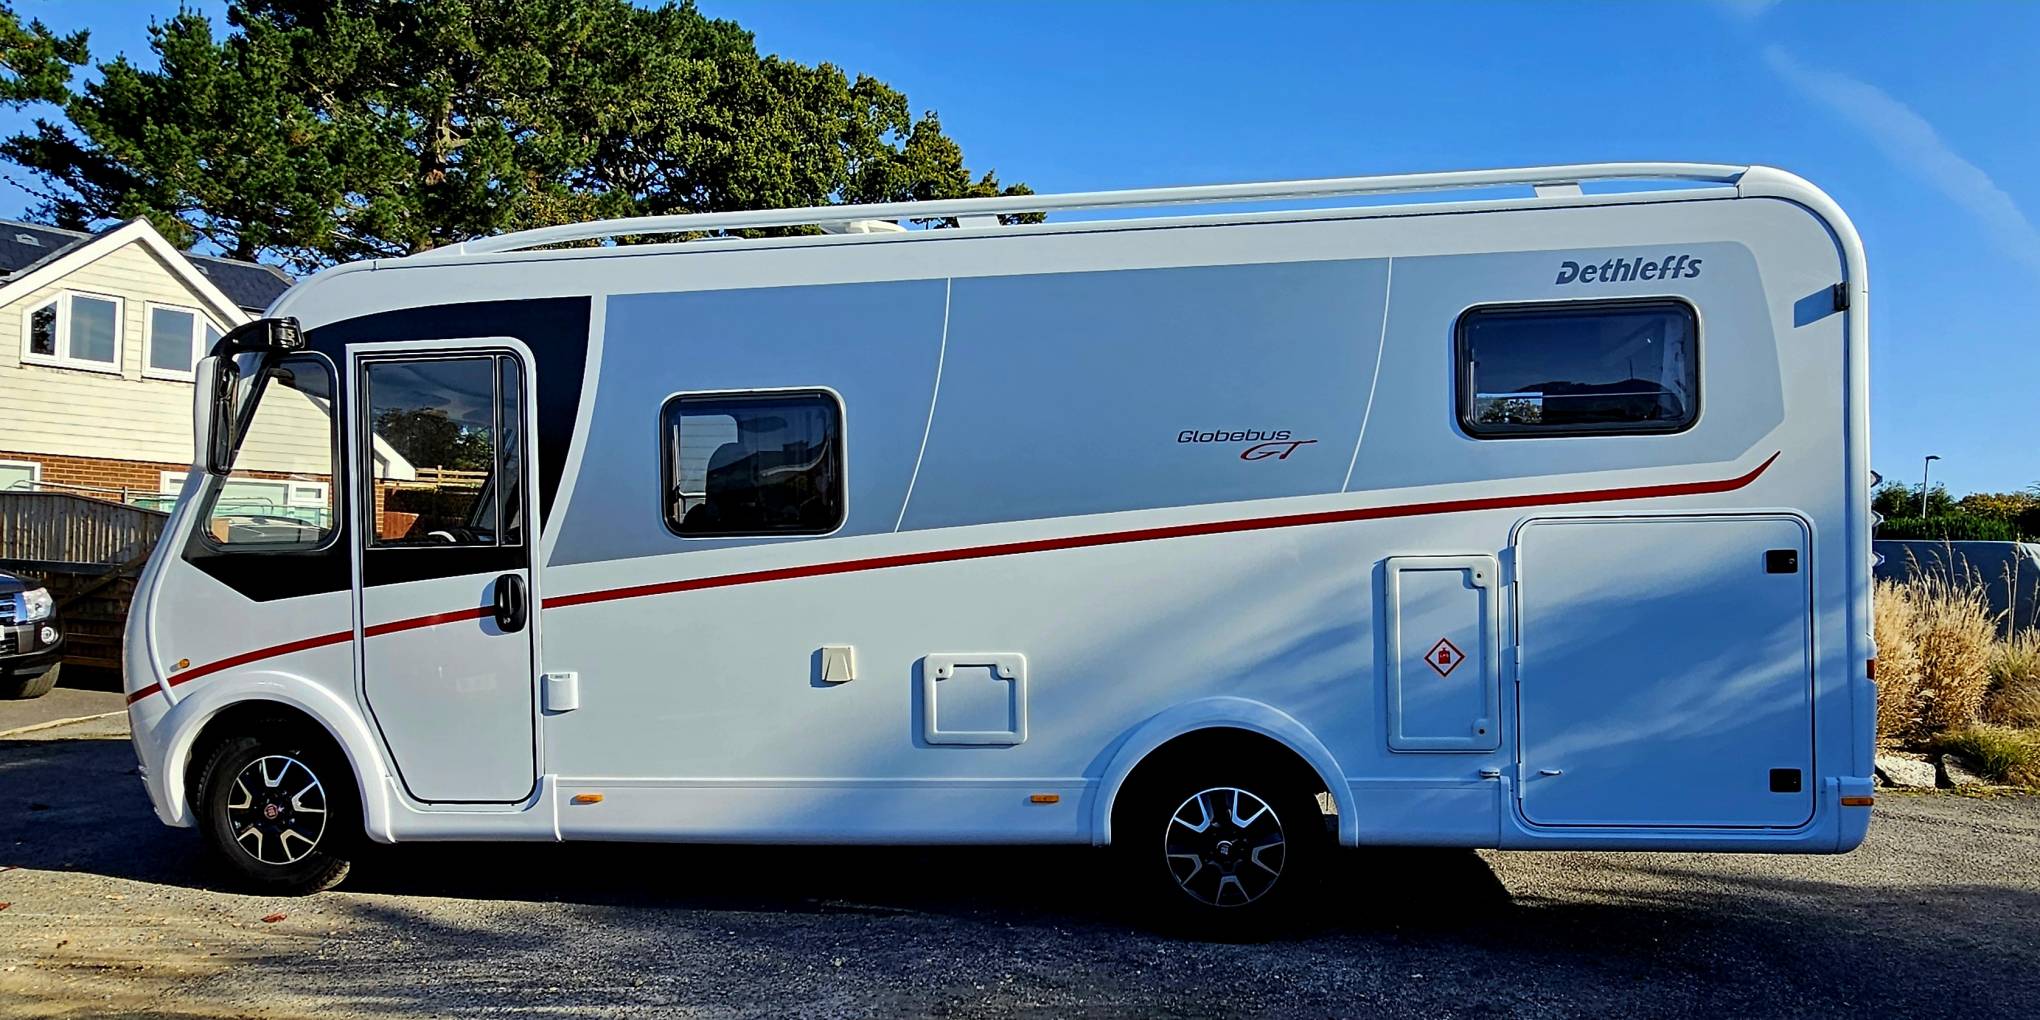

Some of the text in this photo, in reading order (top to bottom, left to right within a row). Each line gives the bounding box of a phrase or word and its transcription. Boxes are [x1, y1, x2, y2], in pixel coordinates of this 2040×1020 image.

[1555, 254, 1703, 285] Dethleffs
[1177, 429, 1292, 443] Globebus
[1240, 440, 1318, 460] GT
